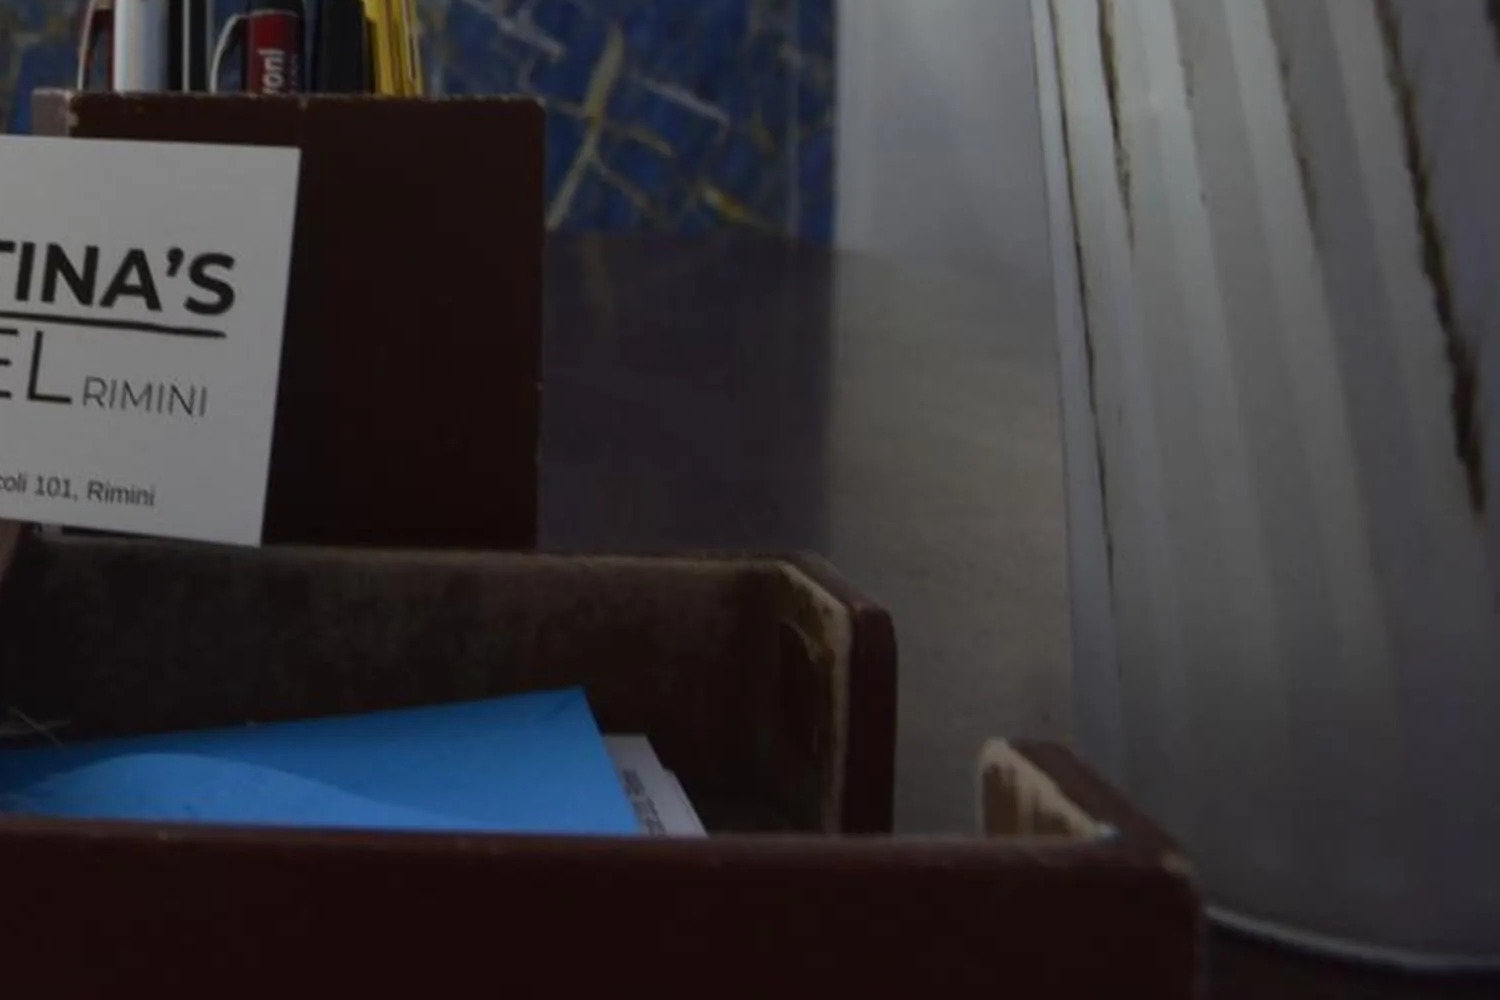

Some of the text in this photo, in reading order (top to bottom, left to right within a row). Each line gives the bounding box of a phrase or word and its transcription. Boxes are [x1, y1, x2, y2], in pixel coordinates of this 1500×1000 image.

[82, 375, 208, 417] RIMINI
[34, 474, 79, 501] 101,
[86, 480, 156, 507] Rimini
